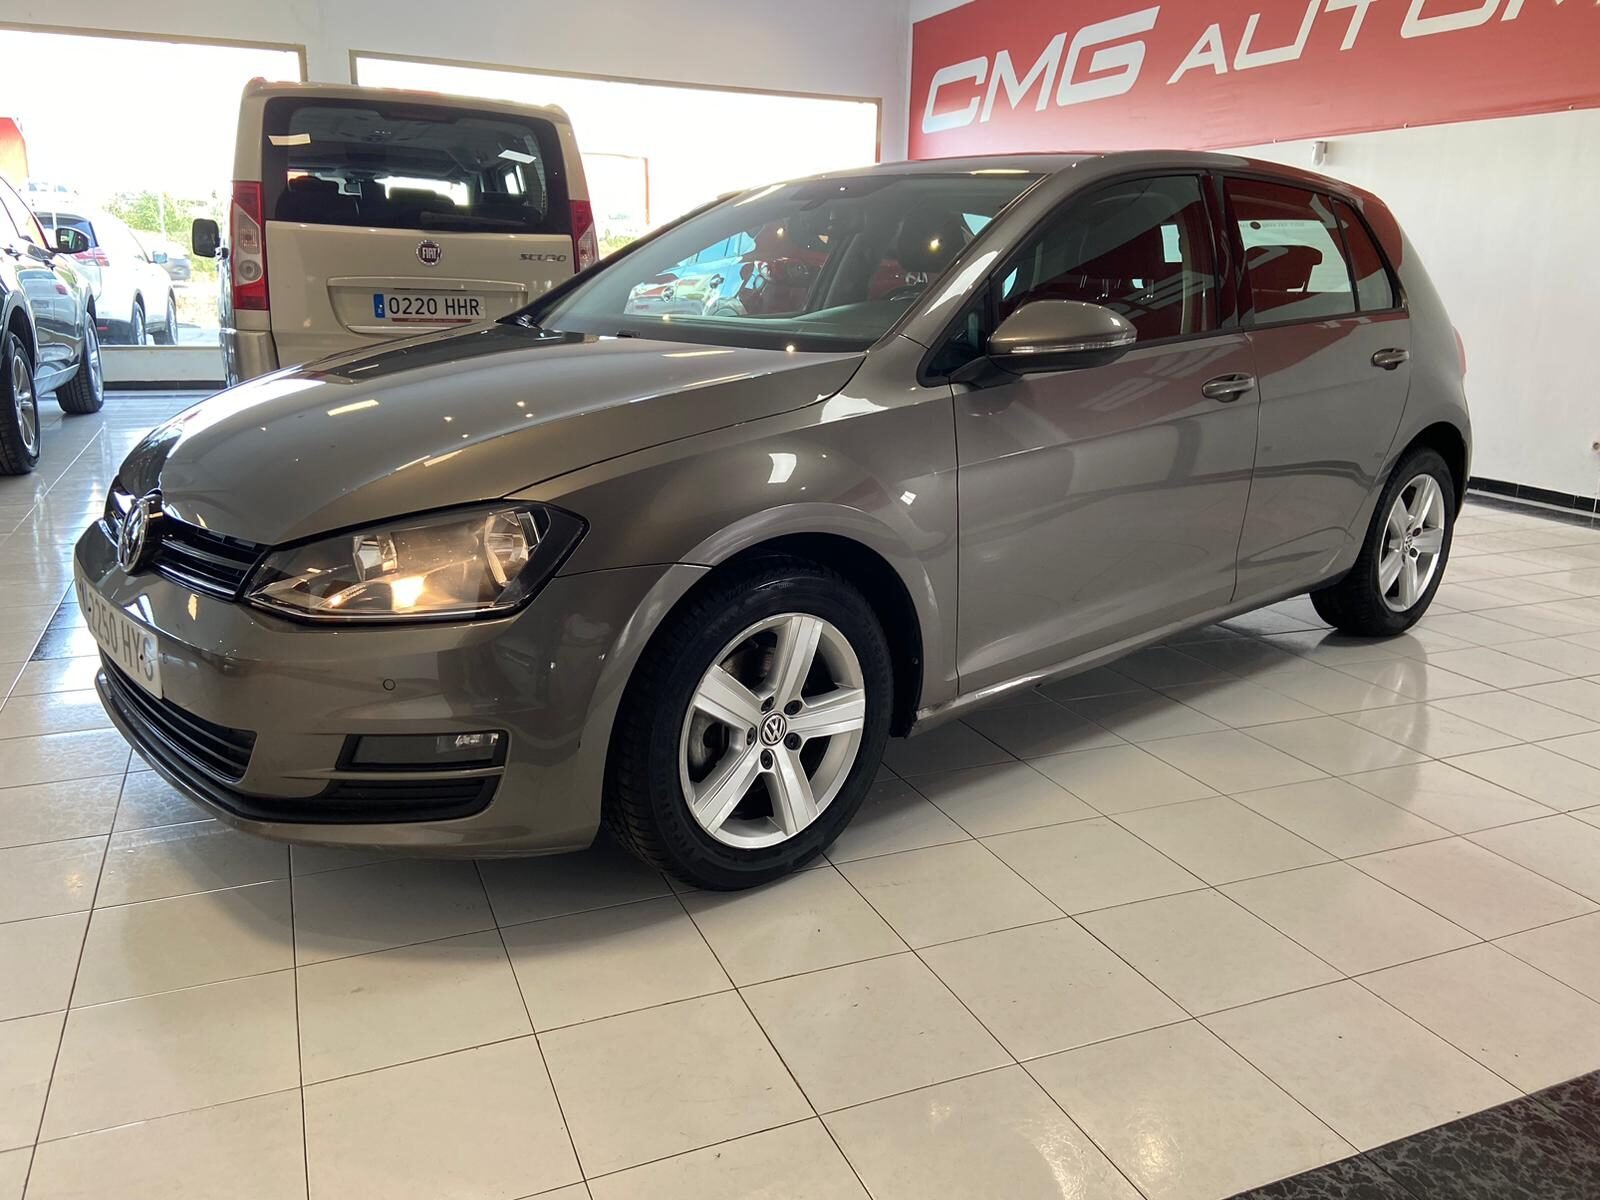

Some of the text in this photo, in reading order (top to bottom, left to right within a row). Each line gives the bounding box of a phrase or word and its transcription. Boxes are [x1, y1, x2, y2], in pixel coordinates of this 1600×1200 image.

[921, 6, 1160, 134] CMG
[422, 246, 438, 259] FIAT
[388, 297, 480, 316] 0220 HHR
